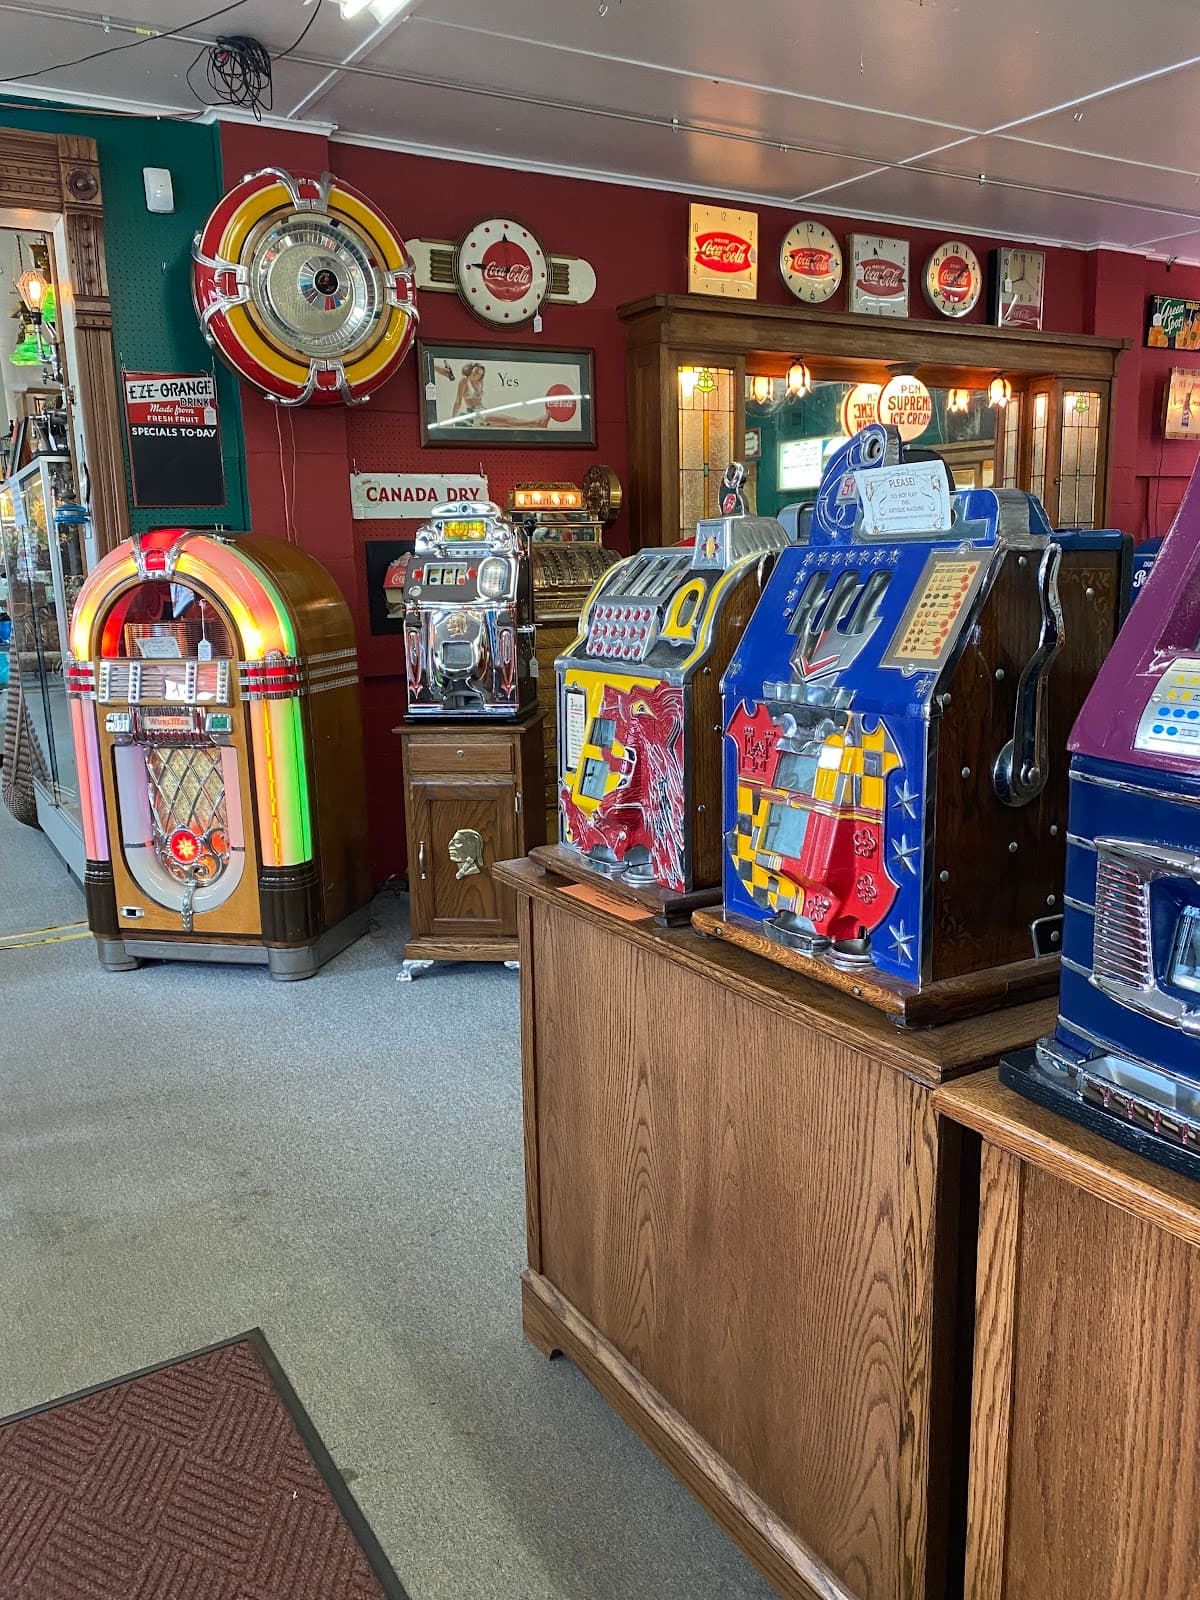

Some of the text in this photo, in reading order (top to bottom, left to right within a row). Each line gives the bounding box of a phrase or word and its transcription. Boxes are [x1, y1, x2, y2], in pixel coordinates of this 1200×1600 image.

[1160, 300, 1184, 327] Green
[497, 372, 520, 387] Yes
[128, 380, 213, 400] EZE-ORANGE
[900, 384, 921, 394] PEN
[180, 397, 209, 408] DRINK
[149, 403, 195, 416] Made from
[147, 415, 173, 423] FRESH
[890, 412, 905, 425] ICE
[131, 427, 217, 438] SPECIALS TO-DAY
[888, 477, 916, 488] PLEASE!
[366, 487, 480, 502] CANADA DRY
